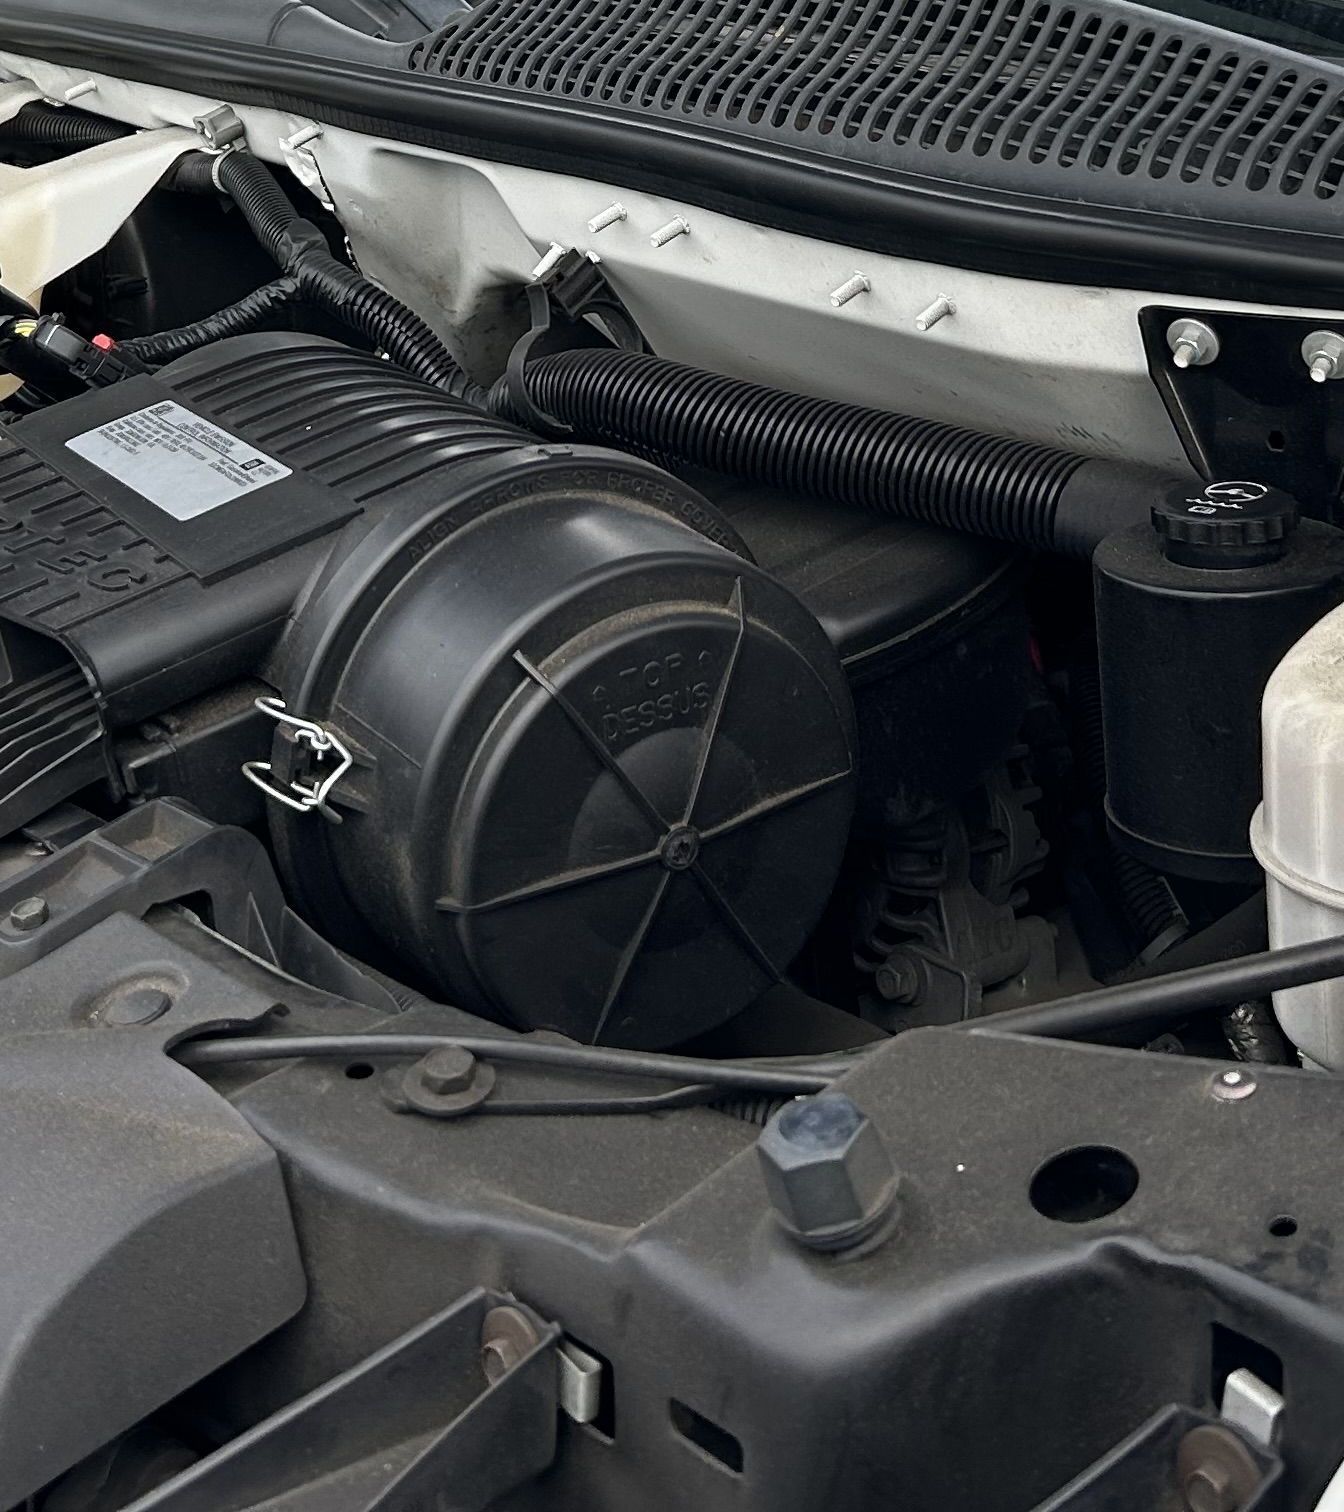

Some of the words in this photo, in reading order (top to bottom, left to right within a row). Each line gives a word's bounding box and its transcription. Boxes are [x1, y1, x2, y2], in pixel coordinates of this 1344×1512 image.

[406, 516, 459, 564] ALIGN
[618, 652, 684, 694] TOP
[601, 681, 710, 744] DESSUS
